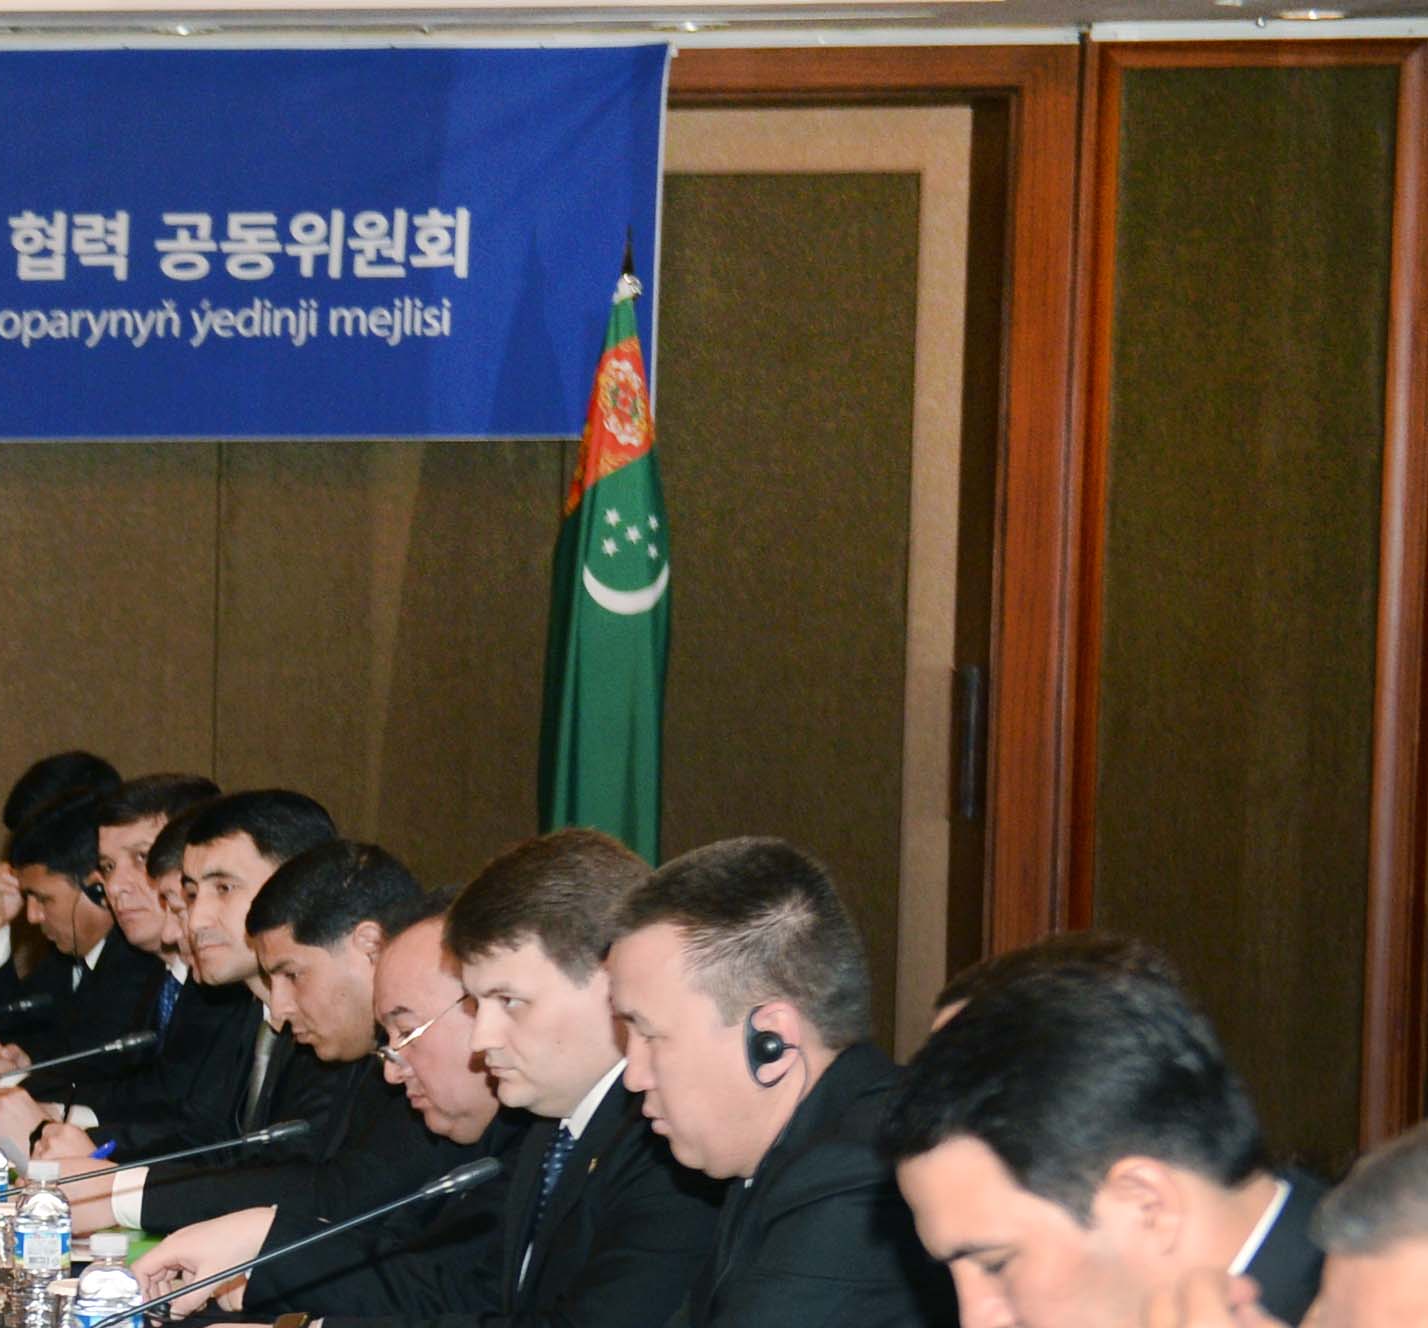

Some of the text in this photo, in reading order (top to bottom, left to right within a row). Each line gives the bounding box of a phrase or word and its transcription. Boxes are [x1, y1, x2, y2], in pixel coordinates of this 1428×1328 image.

[8, 209, 130, 282] 협력
[154, 206, 471, 281] 공동위원회
[329, 297, 453, 347] mejlisi
